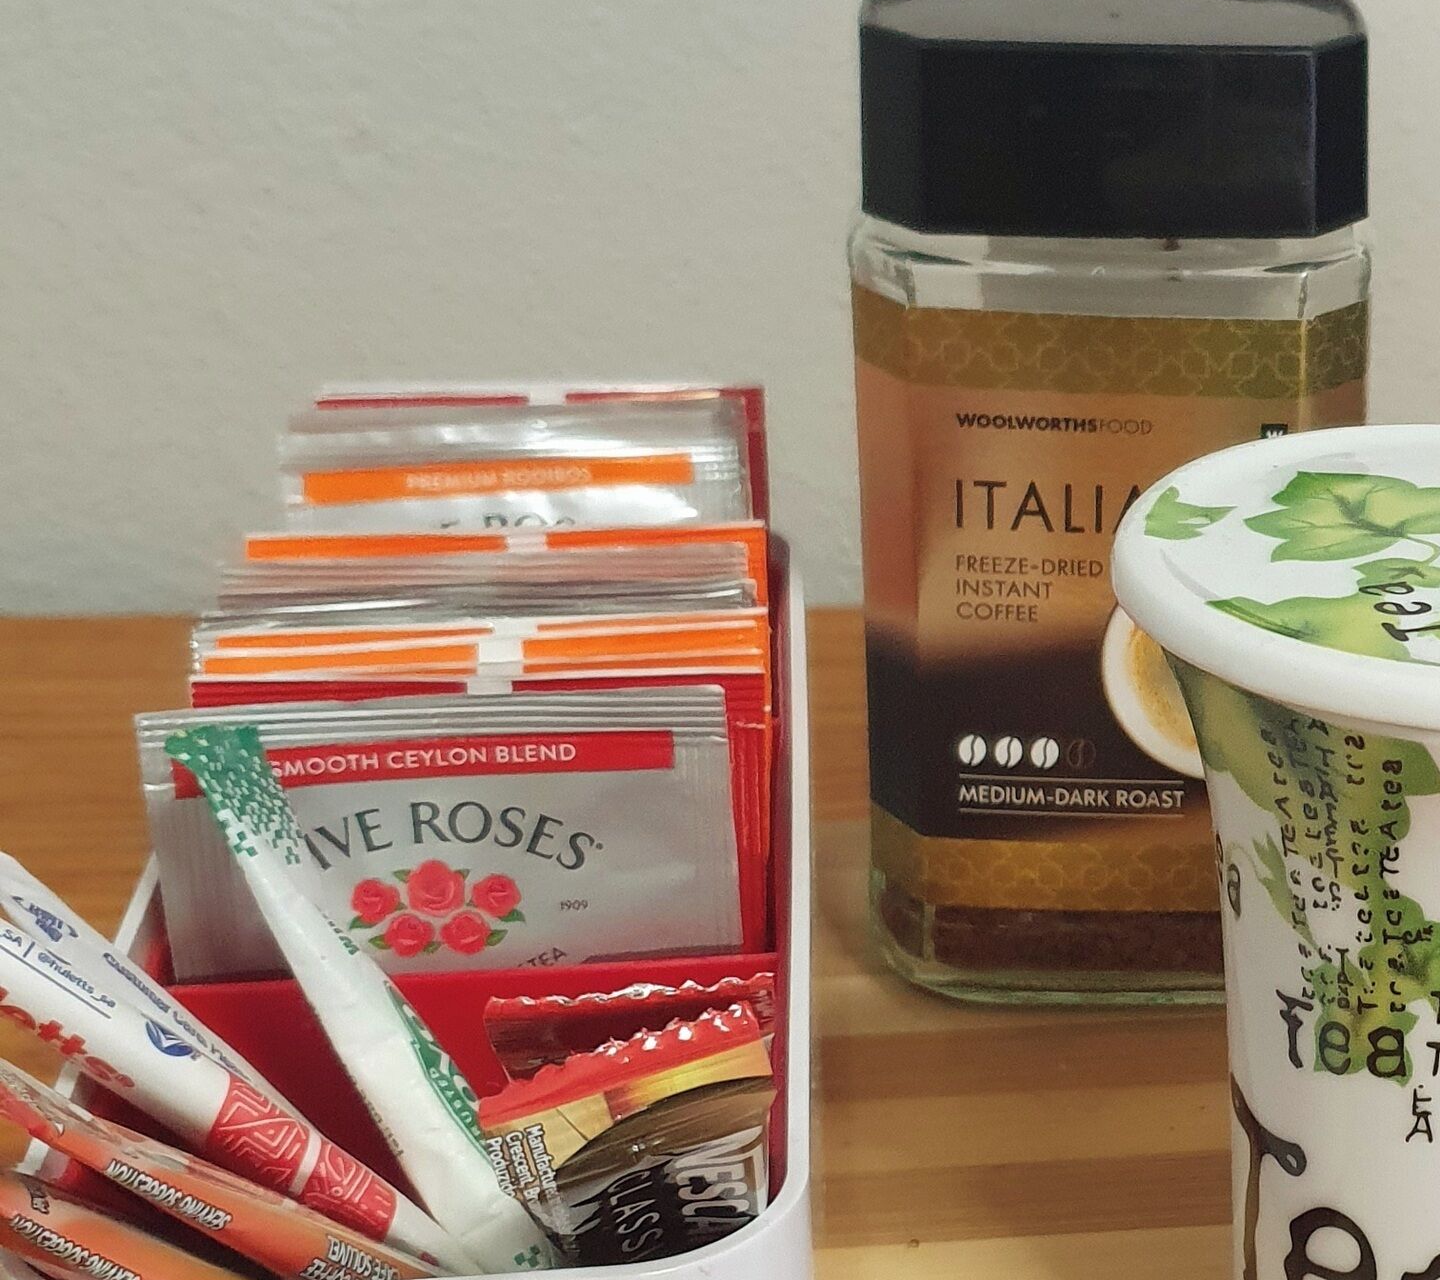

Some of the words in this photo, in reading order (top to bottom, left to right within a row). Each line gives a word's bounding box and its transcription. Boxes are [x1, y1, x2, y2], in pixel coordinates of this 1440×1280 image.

[405, 469, 498, 490] PREMIUM
[956, 554, 1103, 578] FREEZE-DRIED
[956, 578, 1053, 599] INSTANT
[956, 601, 1038, 622] COFFEE
[271, 751, 379, 778] SMOOTH
[386, 746, 488, 770] CEYLON
[495, 742, 577, 764] BLEND
[959, 783, 1110, 808] MEDIUM-DARK
[1116, 788, 1185, 809] ROAST
[303, 807, 393, 871] IVE
[410, 800, 595, 871] ROSES
[559, 900, 589, 912] 1909
[1276, 989, 1406, 1077] Tea
[106, 1159, 182, 1208] SUGGESTION
[178, 1194, 233, 1230] SERVING
[608, 1170, 663, 1254] CLASS
[10, 1214, 89, 1265] SUGGESTION
